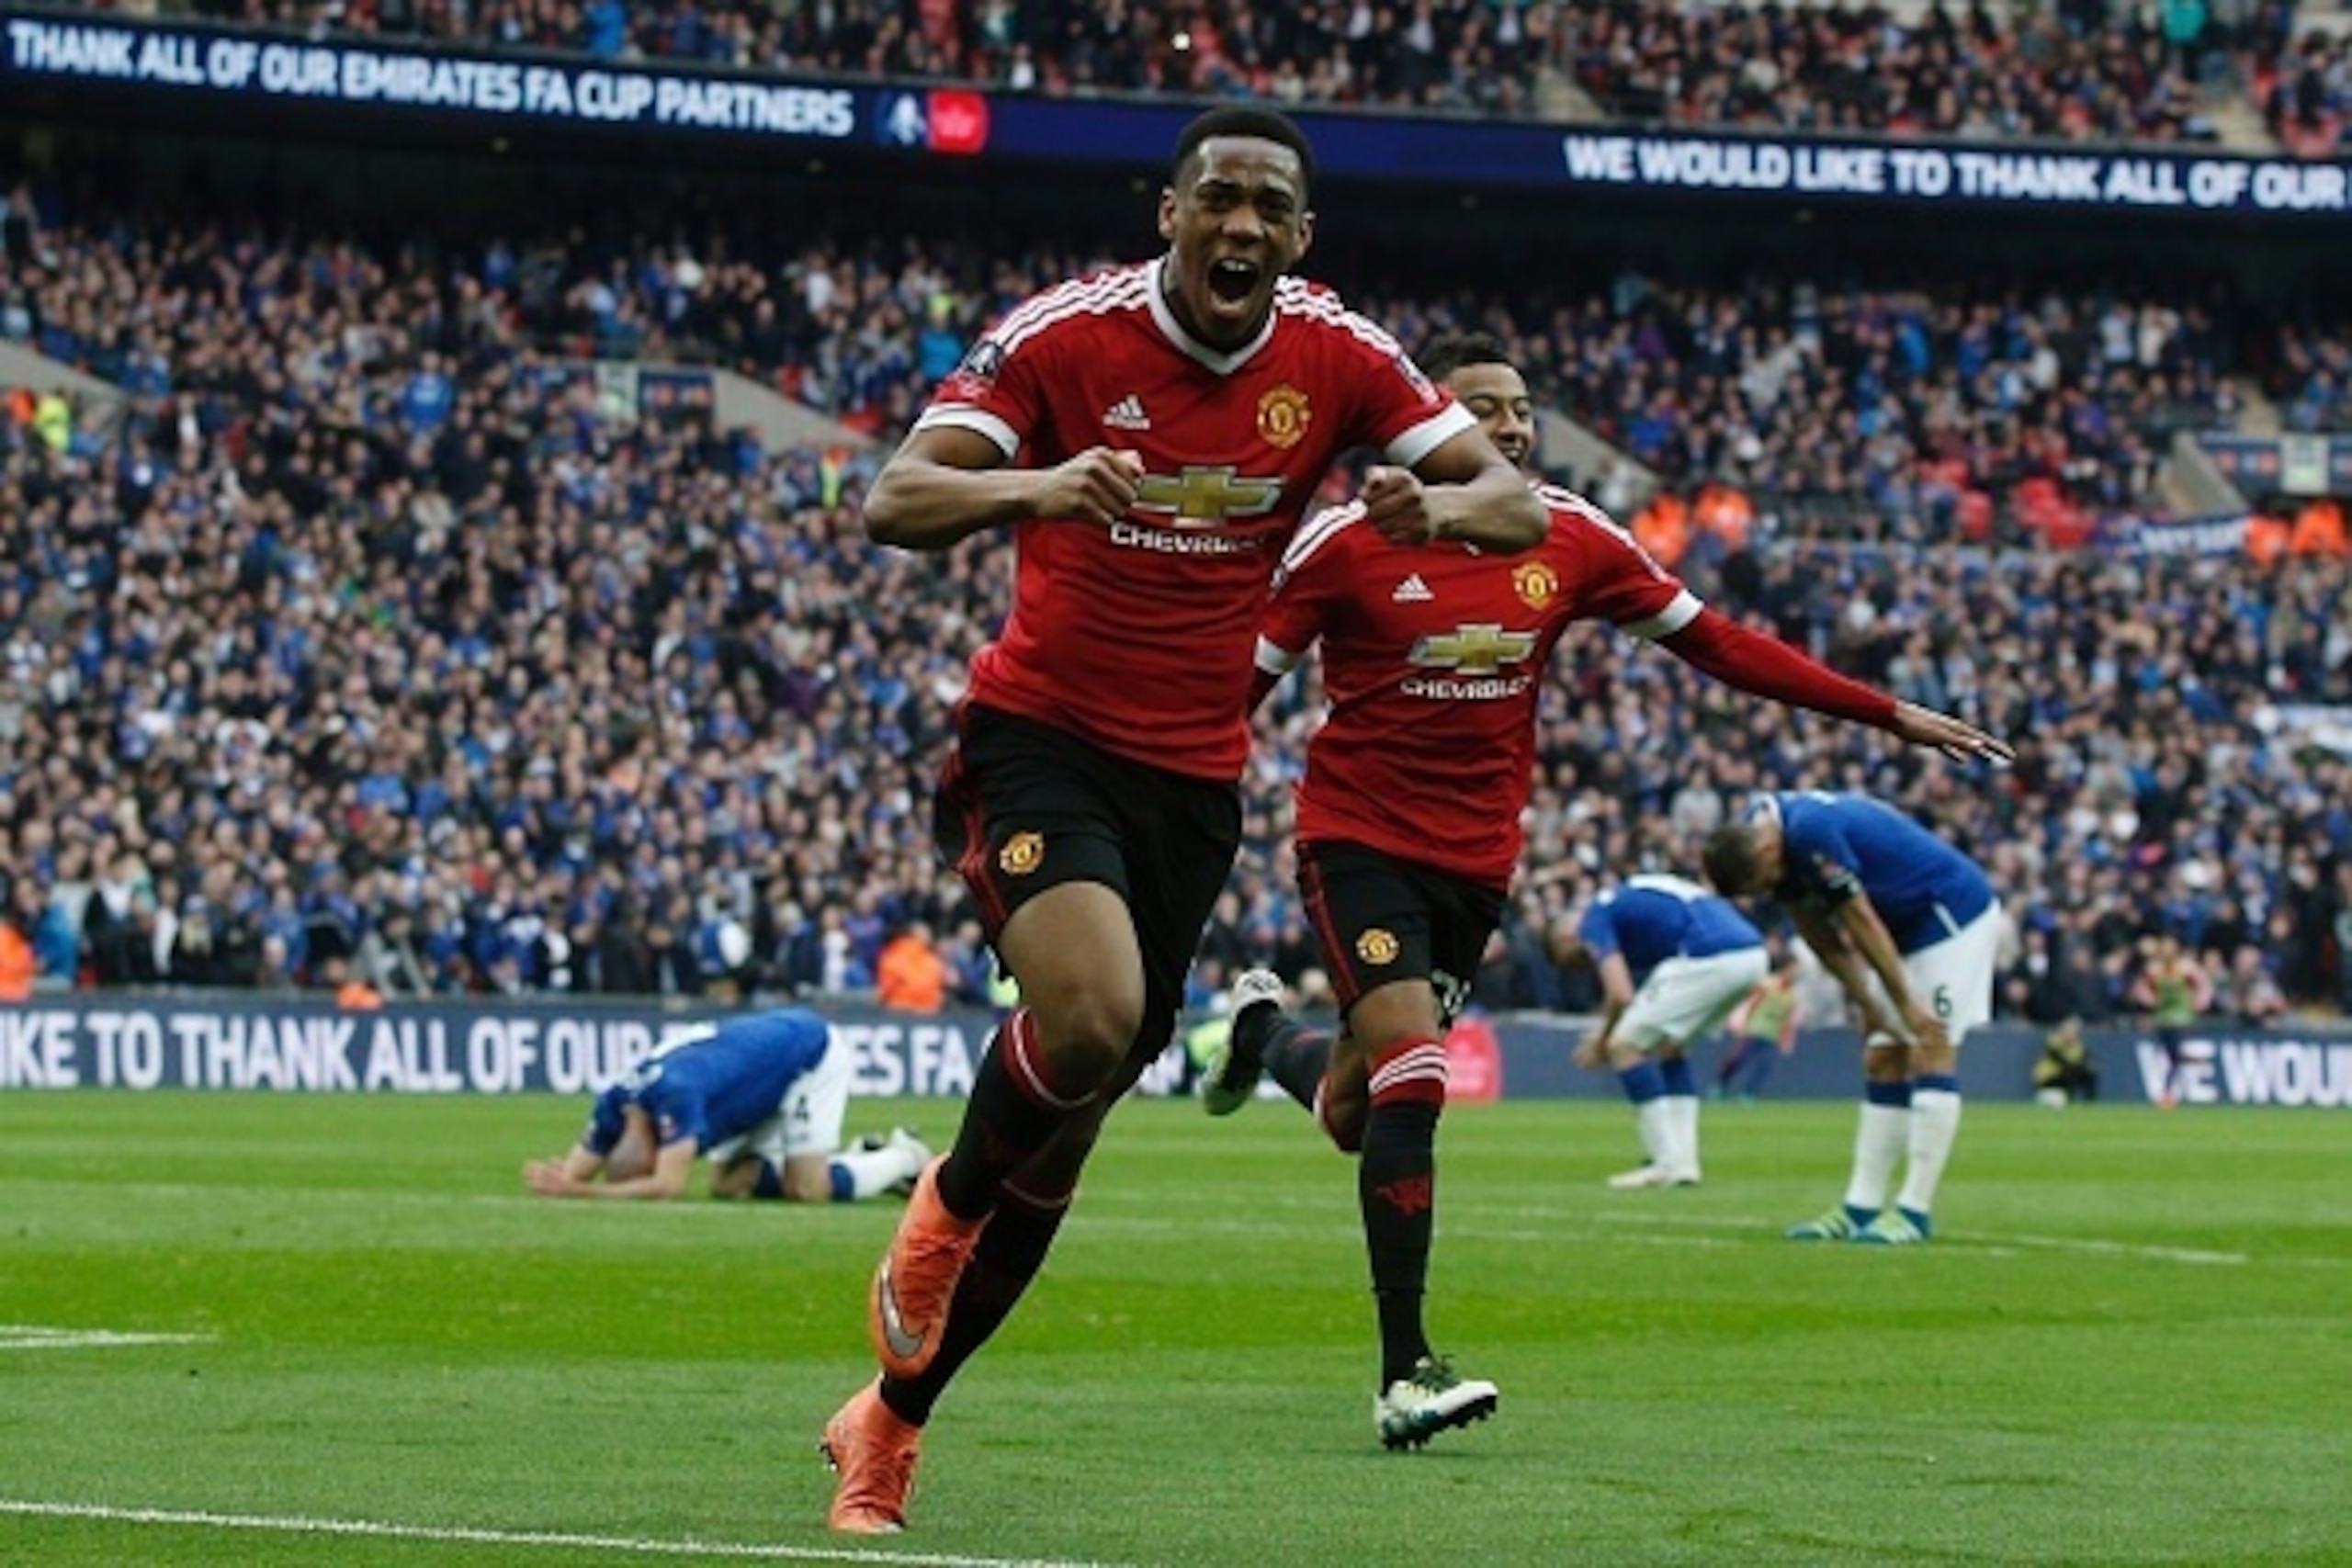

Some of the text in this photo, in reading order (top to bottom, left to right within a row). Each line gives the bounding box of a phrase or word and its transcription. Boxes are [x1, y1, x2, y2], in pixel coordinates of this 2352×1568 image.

[11, 21, 853, 136] THANK ALL OF OUR EMIRATES FA CUP PARTNERS
[1566, 138, 2346, 209] WE WOULD LIKE TO THANK ALL OF OUR
[1110, 521, 1265, 554] CHEVR
[1932, 983, 1952, 1019] 6
[85, 1012, 164, 1090] TO
[170, 1014, 356, 1092] THANK
[366, 1018, 462, 1093] ALL
[468, 1018, 538, 1094] OF
[910, 1025, 974, 1097] FA
[2221, 1041, 2352, 1108] WOU
[794, 1096, 809, 1122] 4
